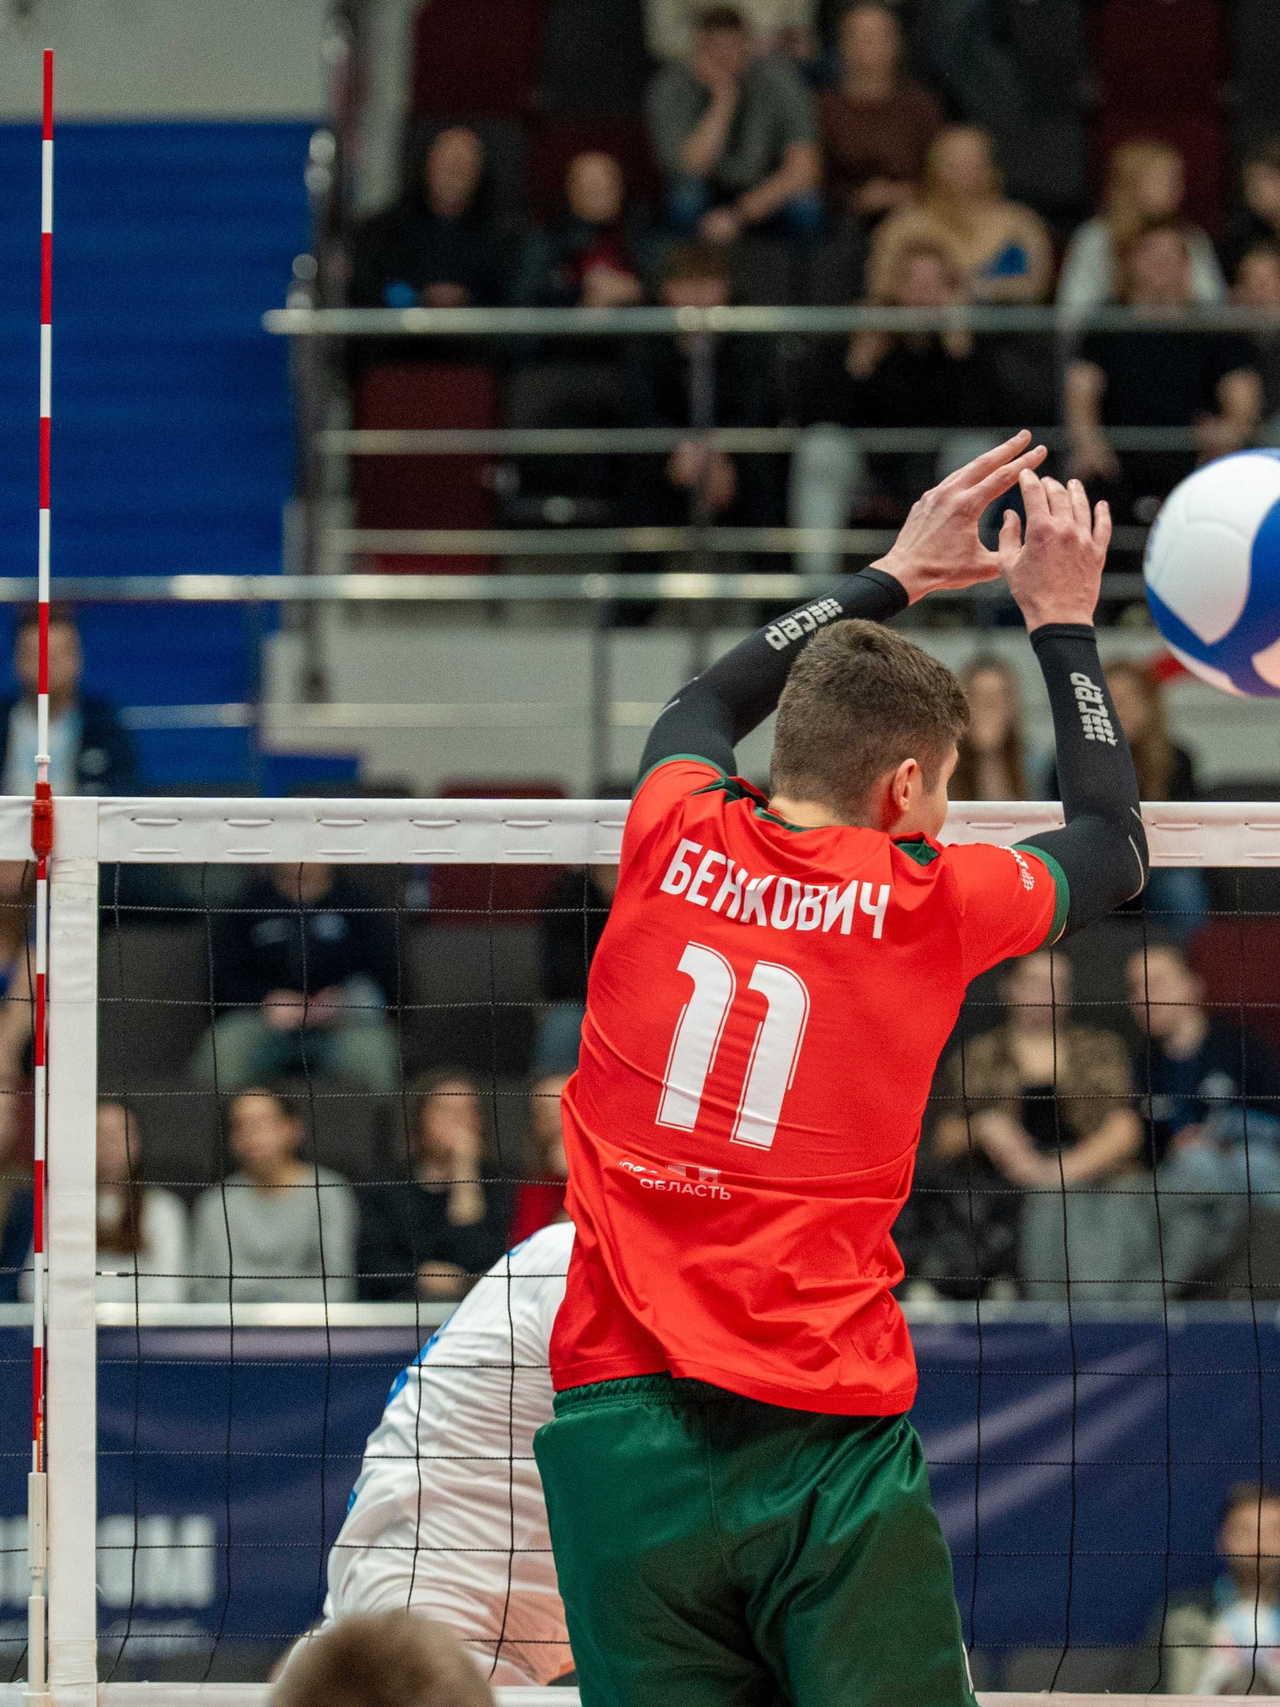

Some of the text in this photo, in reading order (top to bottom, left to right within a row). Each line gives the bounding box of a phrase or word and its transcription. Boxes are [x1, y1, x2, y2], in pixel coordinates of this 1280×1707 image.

[659, 837, 892, 940] БЕНКОВИЧ
[655, 940, 811, 1151] 11
[639, 1178, 732, 1201] ОБЛАСТЬ
